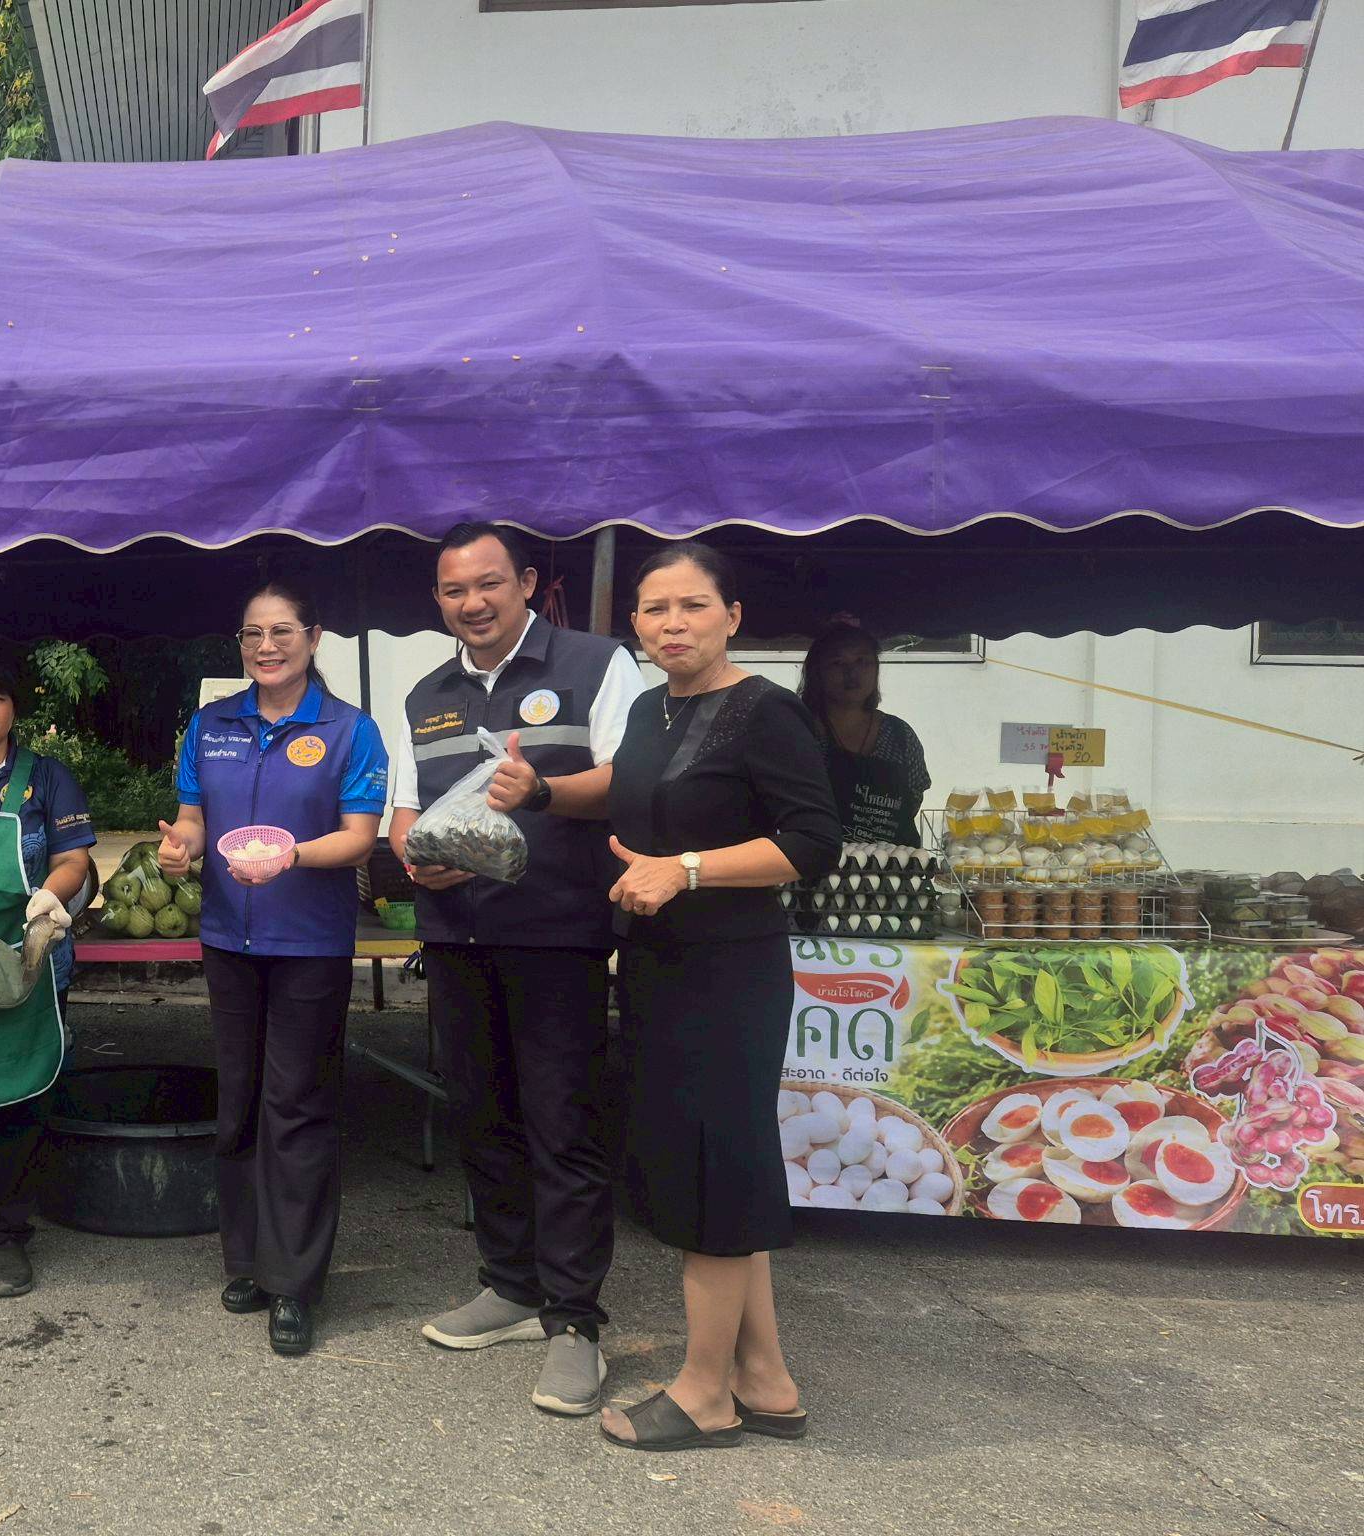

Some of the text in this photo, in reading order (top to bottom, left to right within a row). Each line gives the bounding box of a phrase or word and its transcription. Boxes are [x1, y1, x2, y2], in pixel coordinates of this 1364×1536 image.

[842, 1066, 888, 1083] ดีต่อใจ
[1305, 1189, 1364, 1225] โทร.
